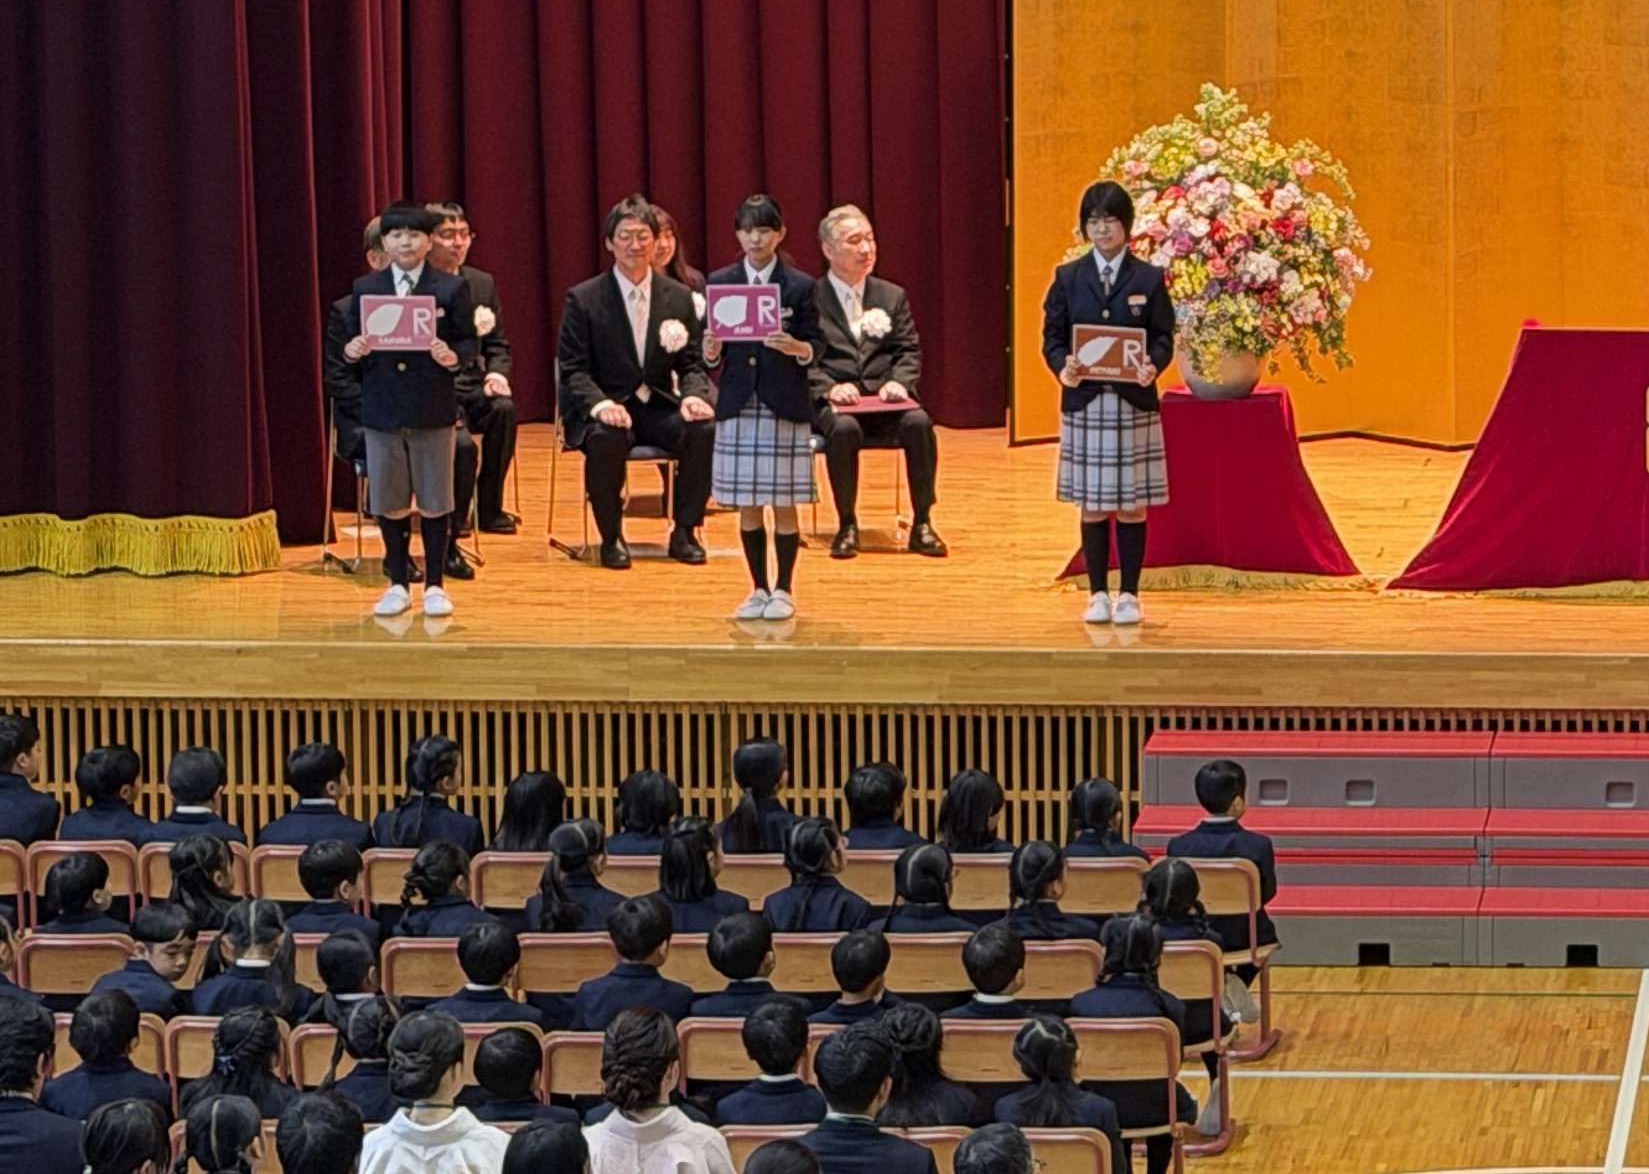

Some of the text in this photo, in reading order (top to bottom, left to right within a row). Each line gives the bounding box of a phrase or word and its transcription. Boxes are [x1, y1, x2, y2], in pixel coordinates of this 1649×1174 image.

[413, 307, 432, 336] R
[757, 295, 777, 324] R
[1123, 339, 1143, 370] R
